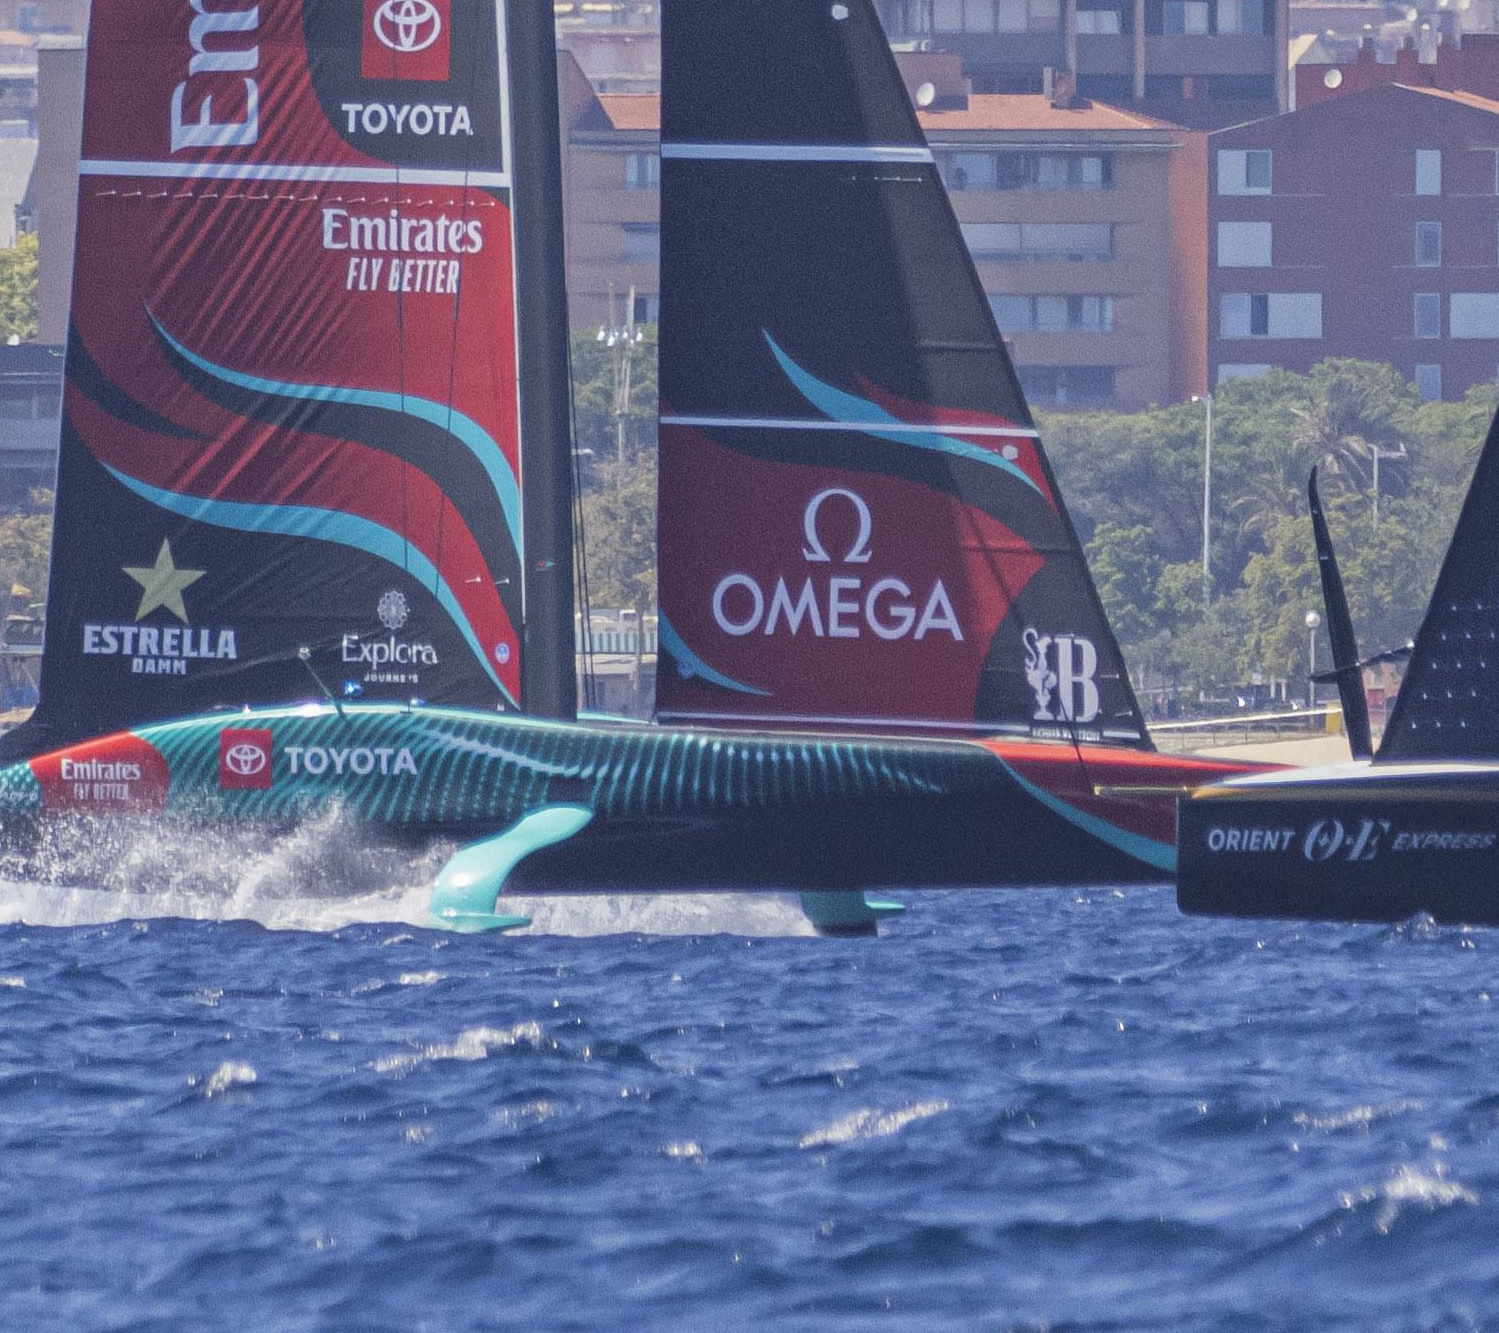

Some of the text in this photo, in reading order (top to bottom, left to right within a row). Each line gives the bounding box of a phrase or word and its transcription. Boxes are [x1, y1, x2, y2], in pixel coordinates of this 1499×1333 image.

[341, 103, 474, 136] TOYOTA
[322, 208, 483, 254] Emirates
[346, 257, 460, 293] FLY BETTER
[712, 573, 964, 641] OMEGA
[83, 624, 237, 660] ESTRELLA
[341, 633, 439, 670] Explora
[131, 658, 186, 675] DAMM
[60, 758, 142, 781] Emirates
[284, 745, 418, 776] TOYOTA
[1207, 828, 1295, 851] ORIENT
[1392, 832, 1496, 850] EXPRESS
